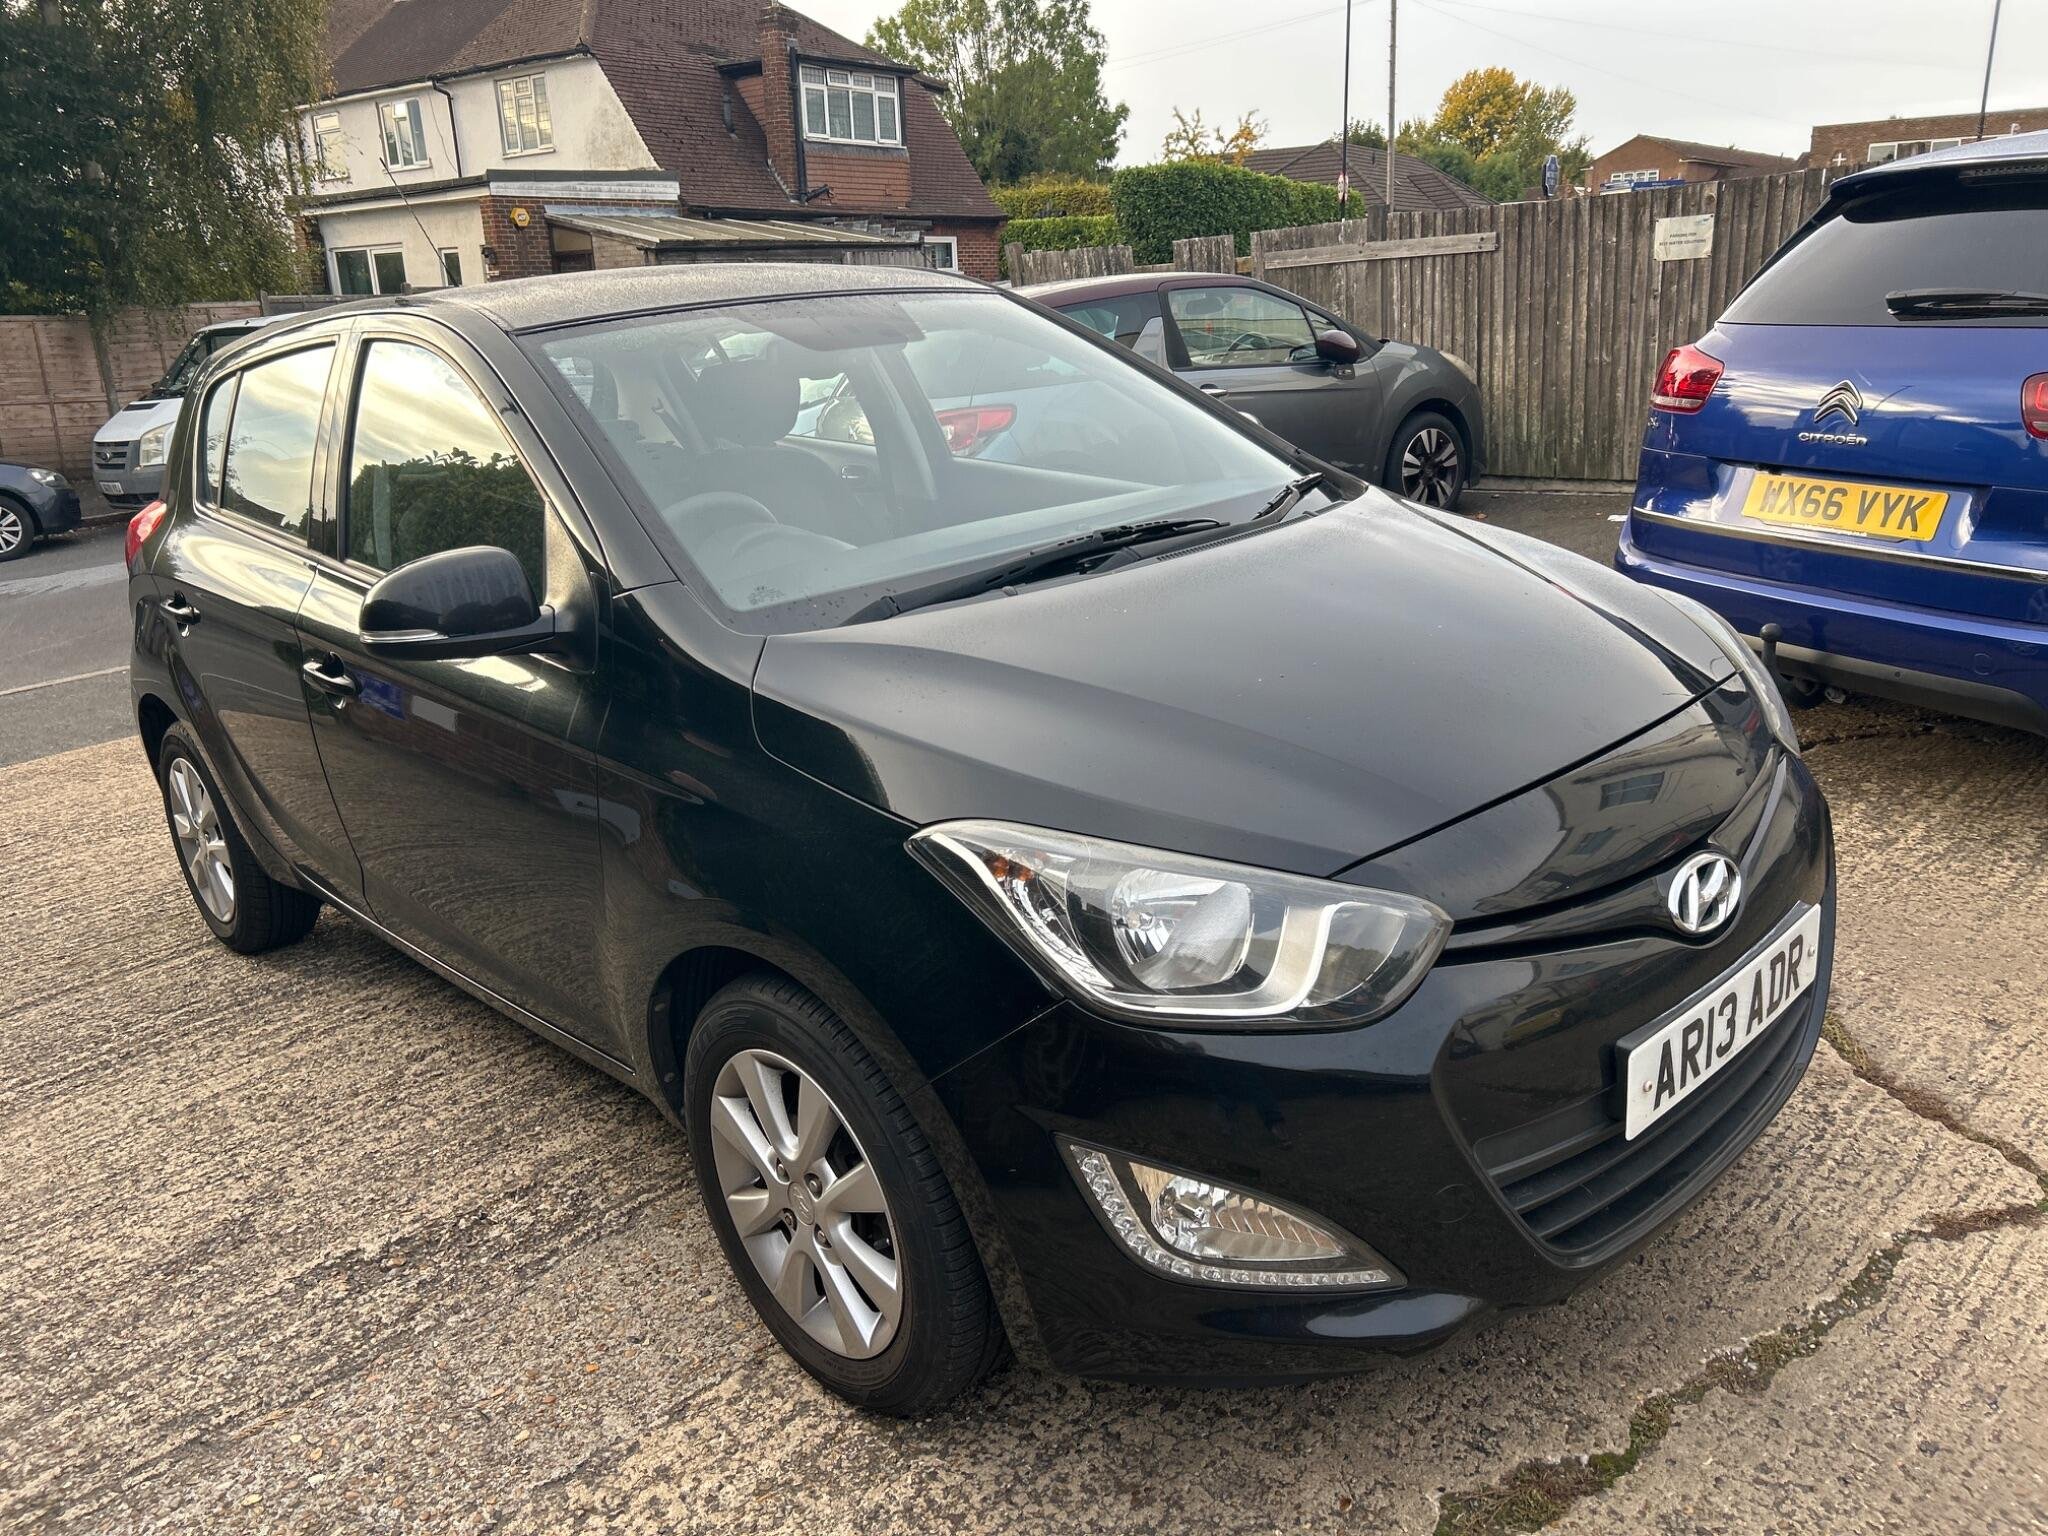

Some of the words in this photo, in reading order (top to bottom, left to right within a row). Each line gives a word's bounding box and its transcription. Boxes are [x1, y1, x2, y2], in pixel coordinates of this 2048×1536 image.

[1759, 480, 1848, 521] WX66
[1856, 489, 1930, 532] VYK
[1653, 992, 1738, 1111] AR13
[1746, 934, 1804, 1037] ADR
